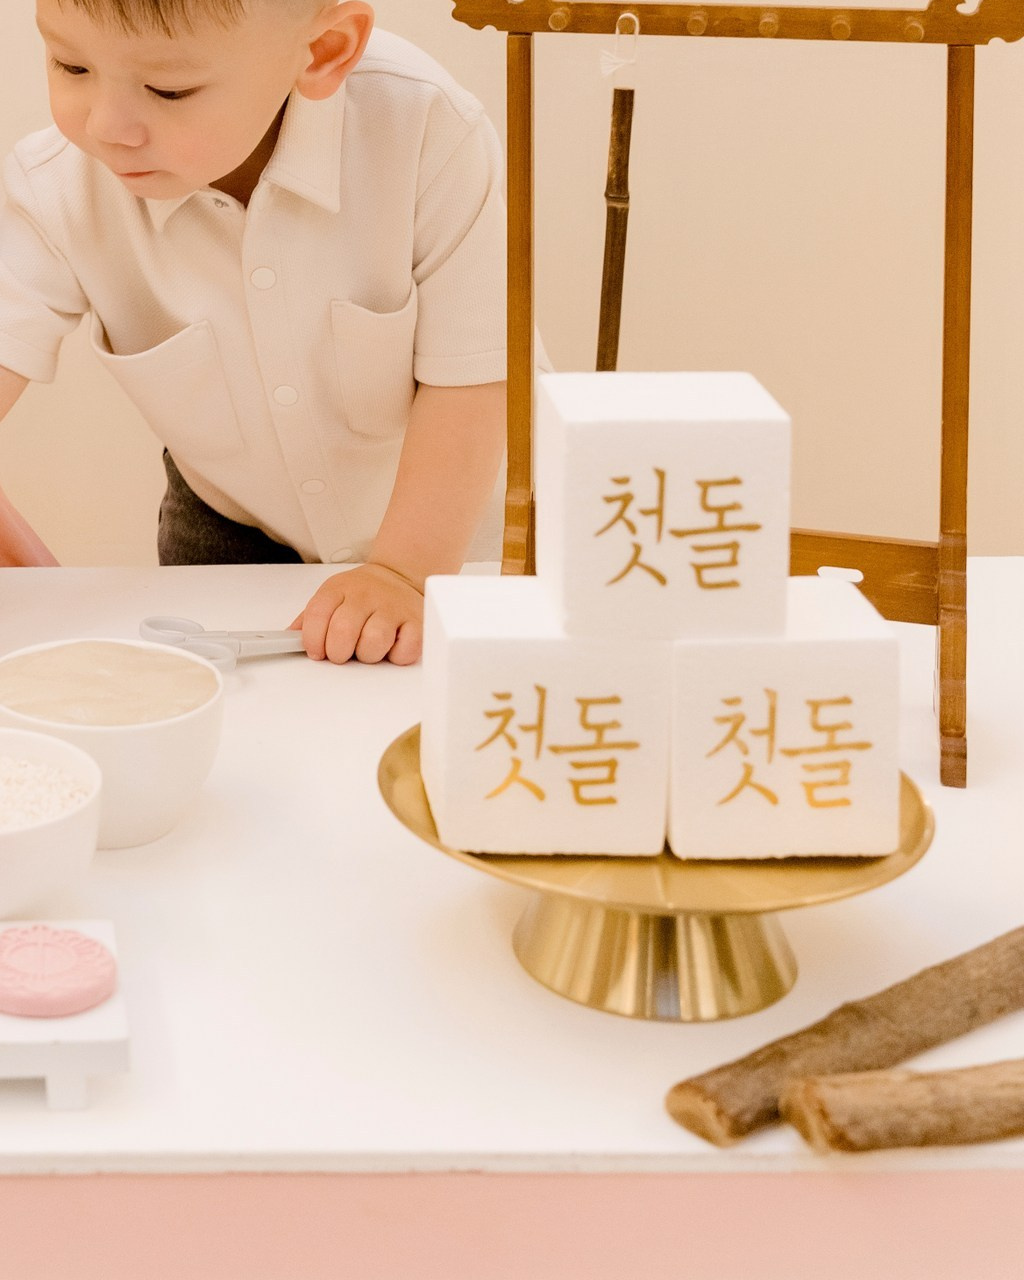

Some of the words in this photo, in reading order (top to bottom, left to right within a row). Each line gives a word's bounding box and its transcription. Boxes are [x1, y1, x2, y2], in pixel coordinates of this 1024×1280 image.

[593, 466, 763, 591] 첫돌
[474, 683, 641, 807] 첫돌
[704, 687, 874, 809] 첫돌
